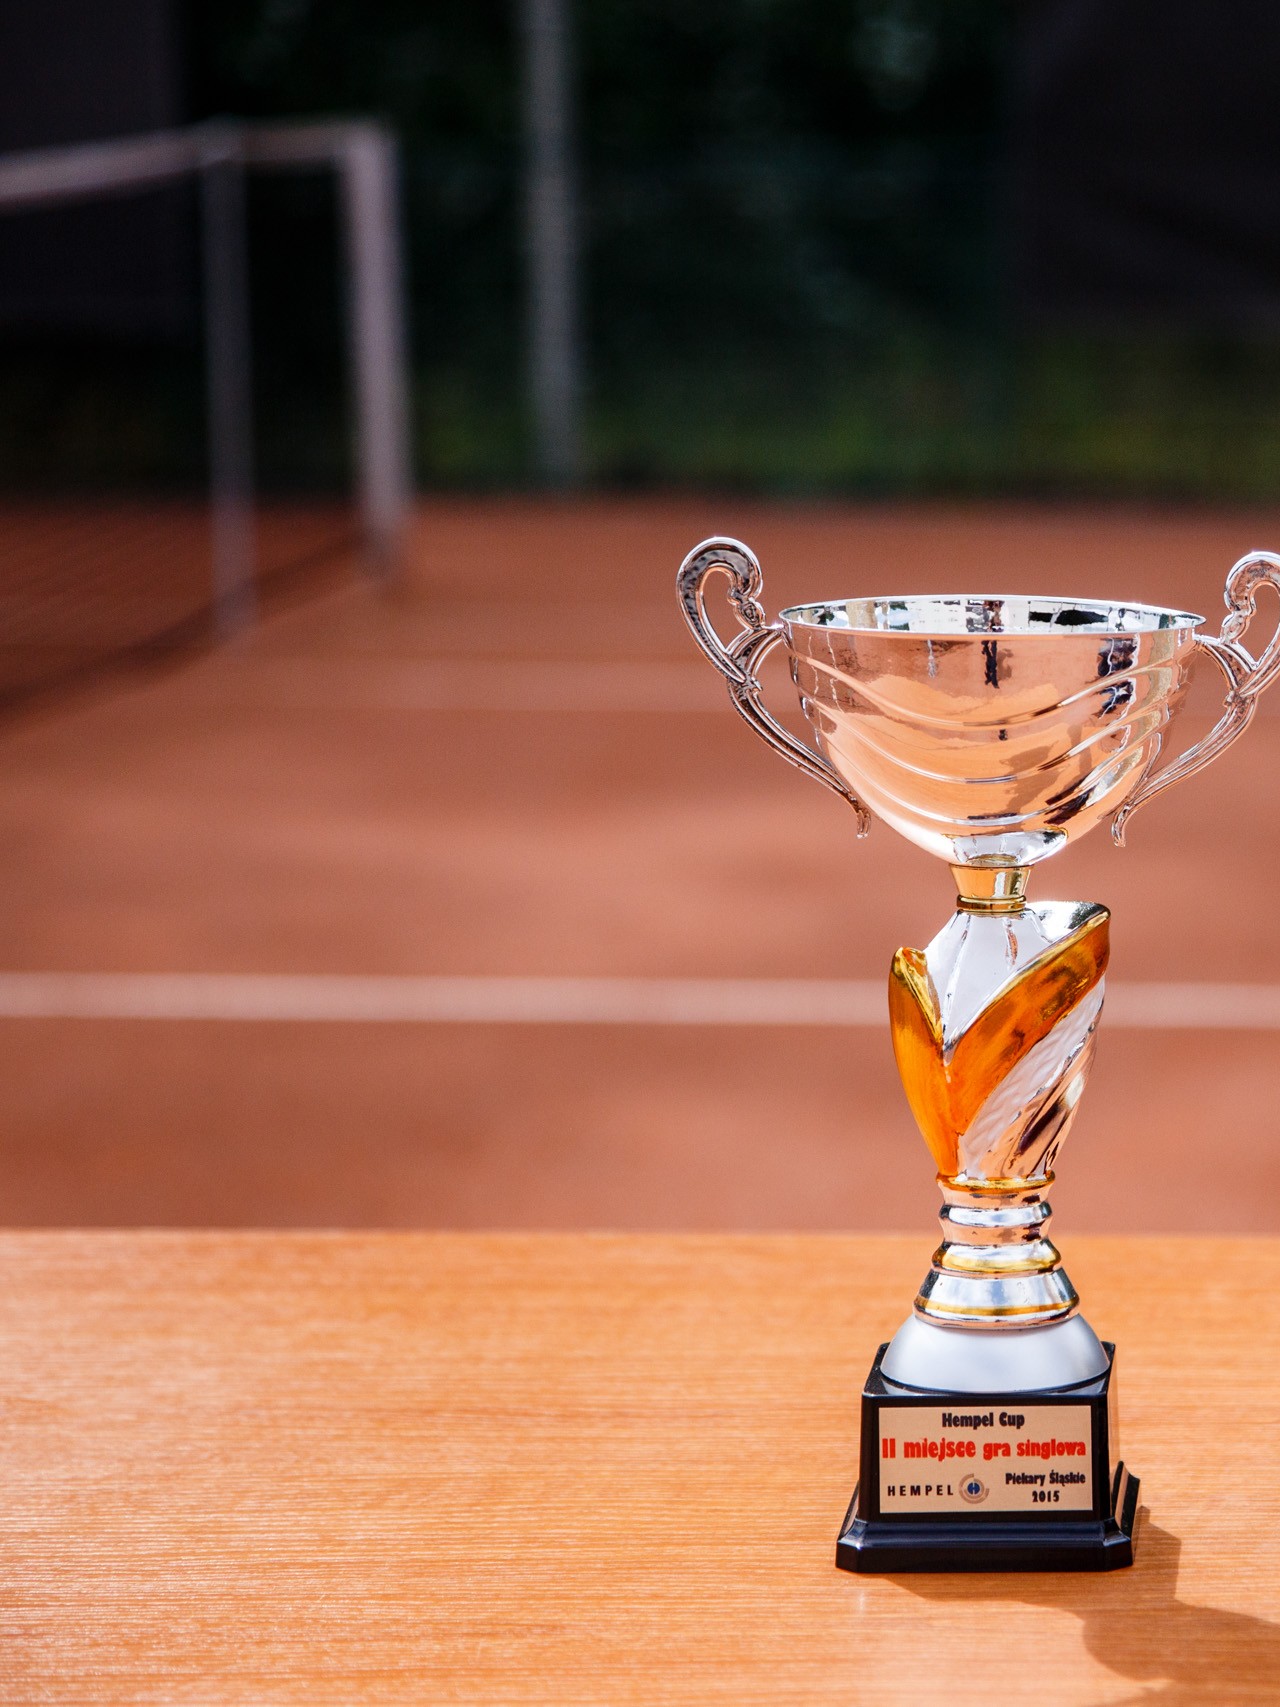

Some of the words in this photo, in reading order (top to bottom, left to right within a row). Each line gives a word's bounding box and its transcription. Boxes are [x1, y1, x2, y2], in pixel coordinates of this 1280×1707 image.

[941, 1411, 994, 1430] Hempel
[999, 1411, 1026, 1429] Cup
[882, 1438, 896, 1459] II
[903, 1437, 976, 1462] miejsce
[983, 1442, 1011, 1461] gra
[1016, 1438, 1087, 1460] singlowa
[1005, 1472, 1046, 1487] Piekary
[1049, 1469, 1086, 1488] Śląskie
[887, 1484, 954, 1497] HEMPEL
[1031, 1490, 1060, 1503] 2015
